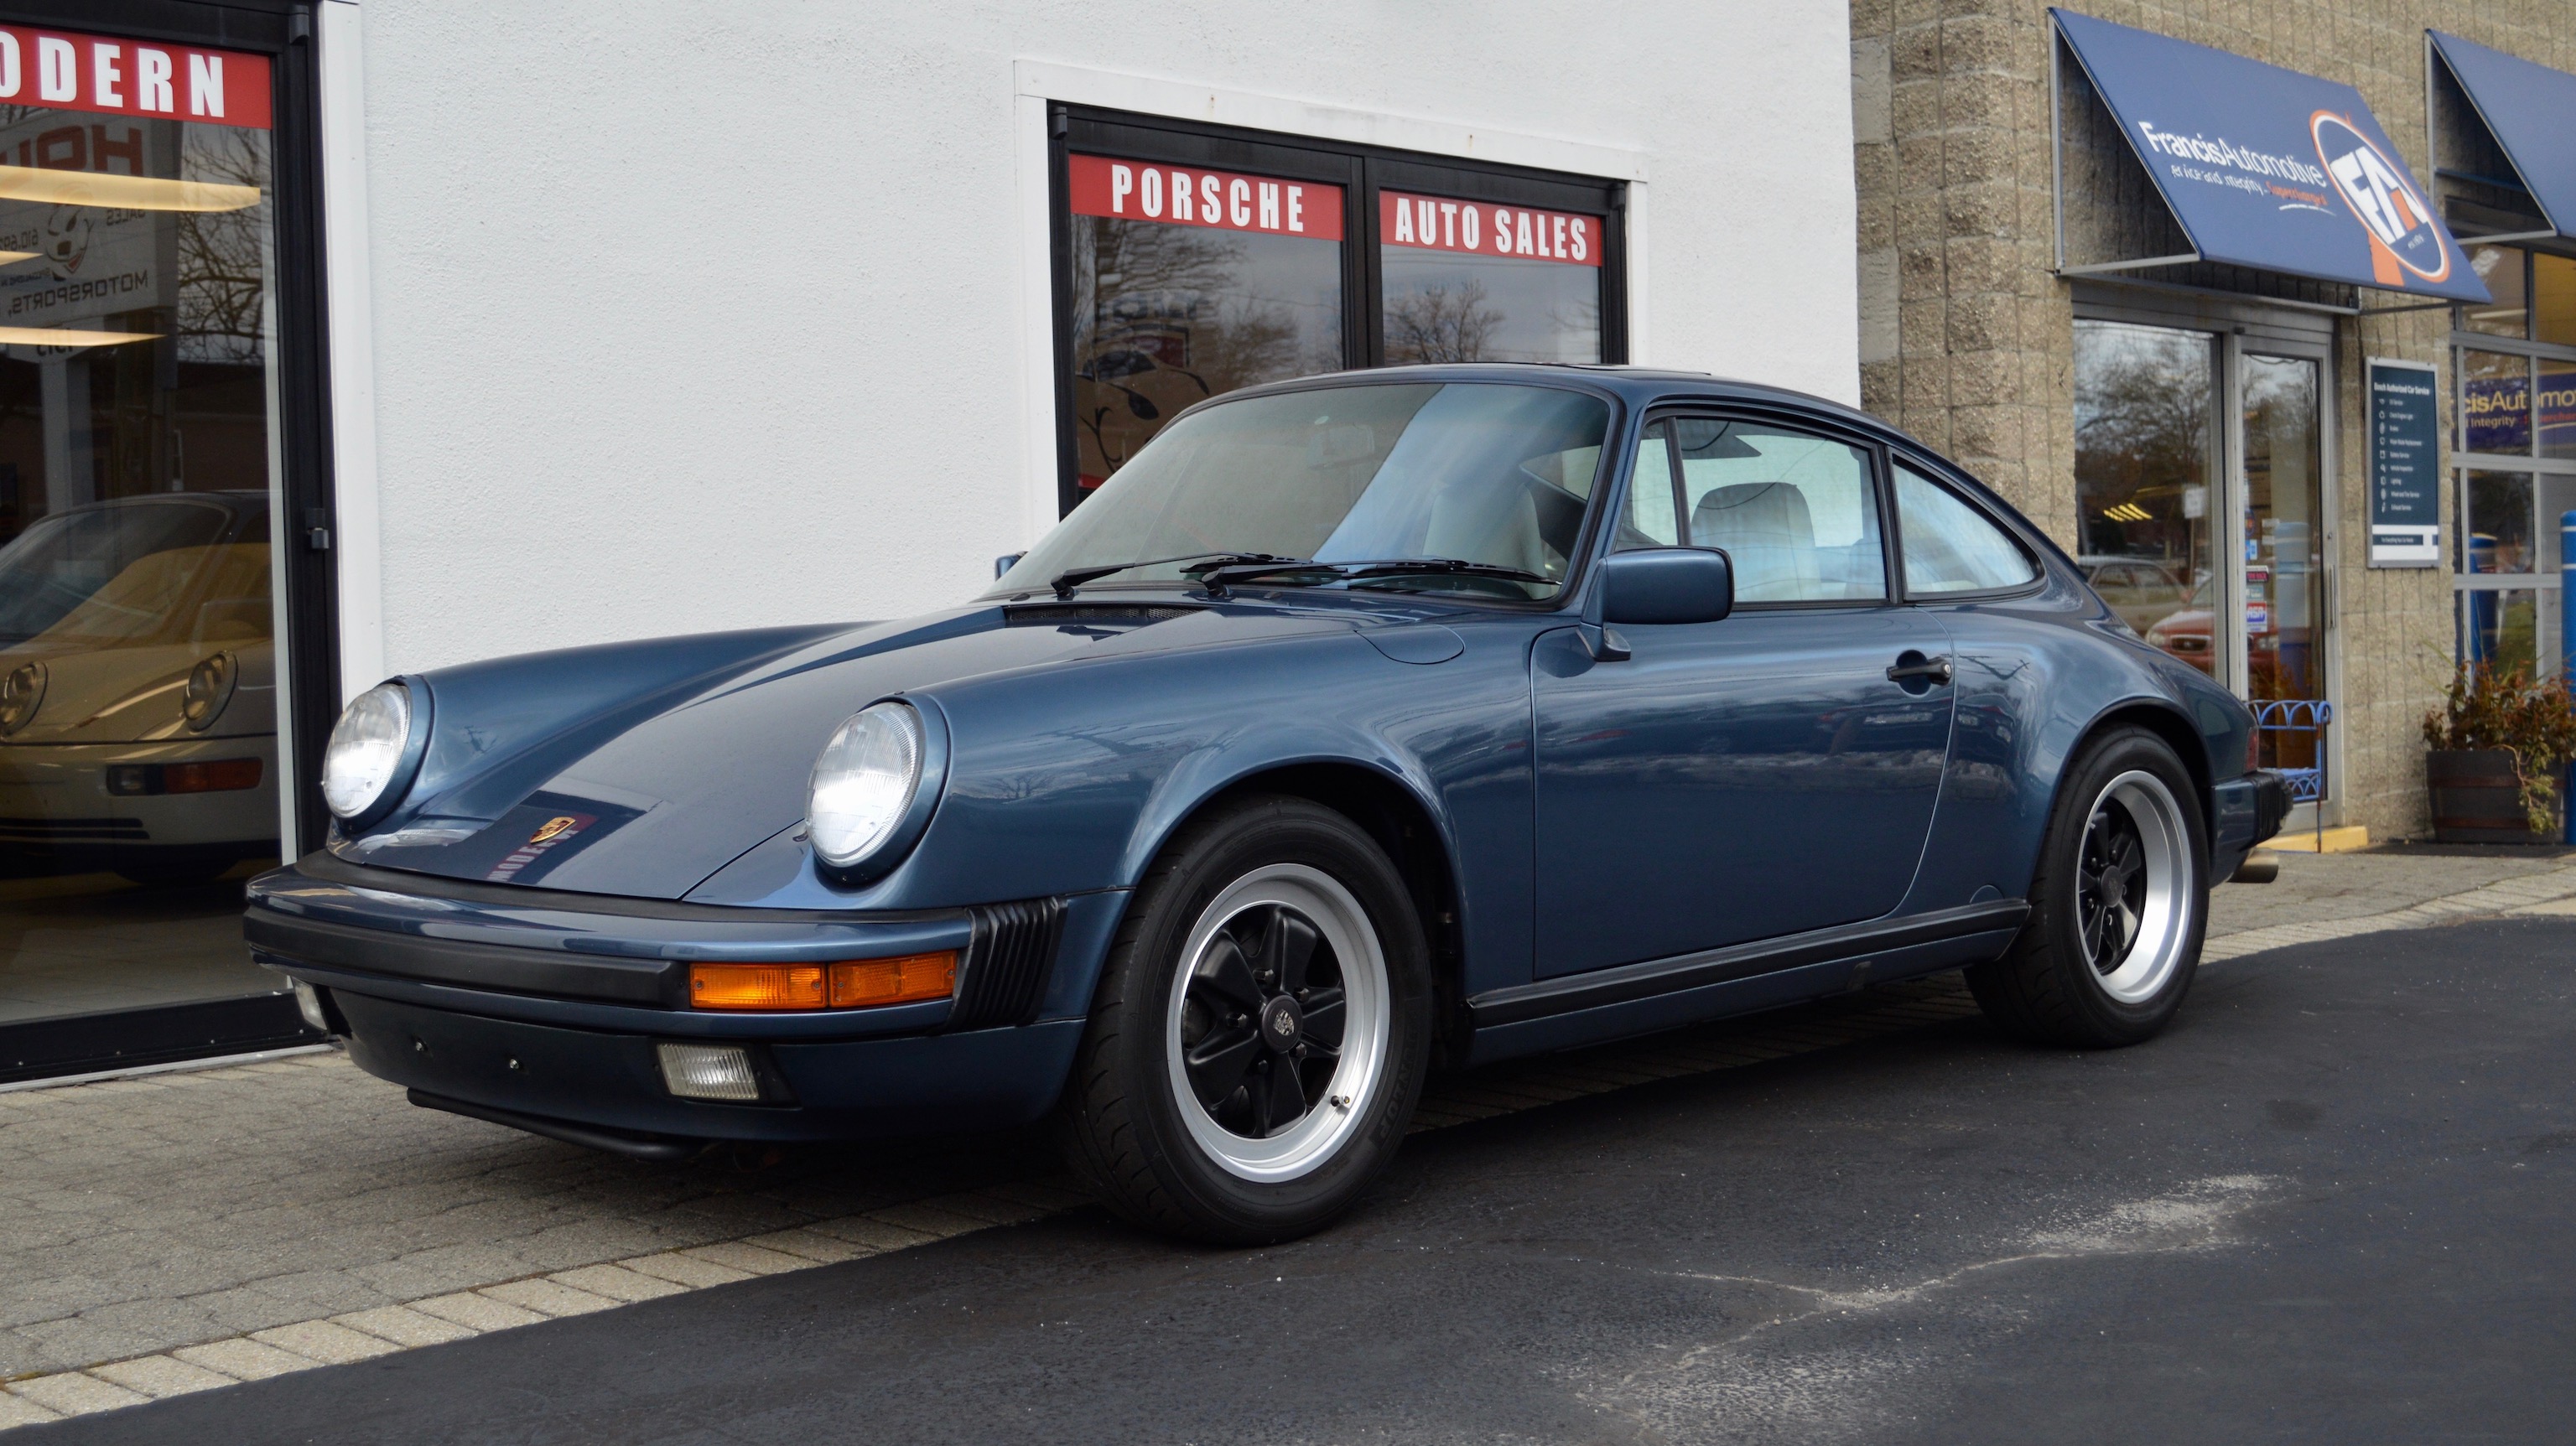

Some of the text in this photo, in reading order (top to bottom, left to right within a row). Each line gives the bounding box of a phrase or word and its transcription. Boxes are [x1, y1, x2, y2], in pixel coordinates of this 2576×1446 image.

[2138, 122, 2327, 188] FrancisAutomotive
[2224, 175, 2264, 196] ntegrity
[1111, 164, 1304, 232] PORSCHE
[1395, 198, 1587, 262] AUTO SALES
